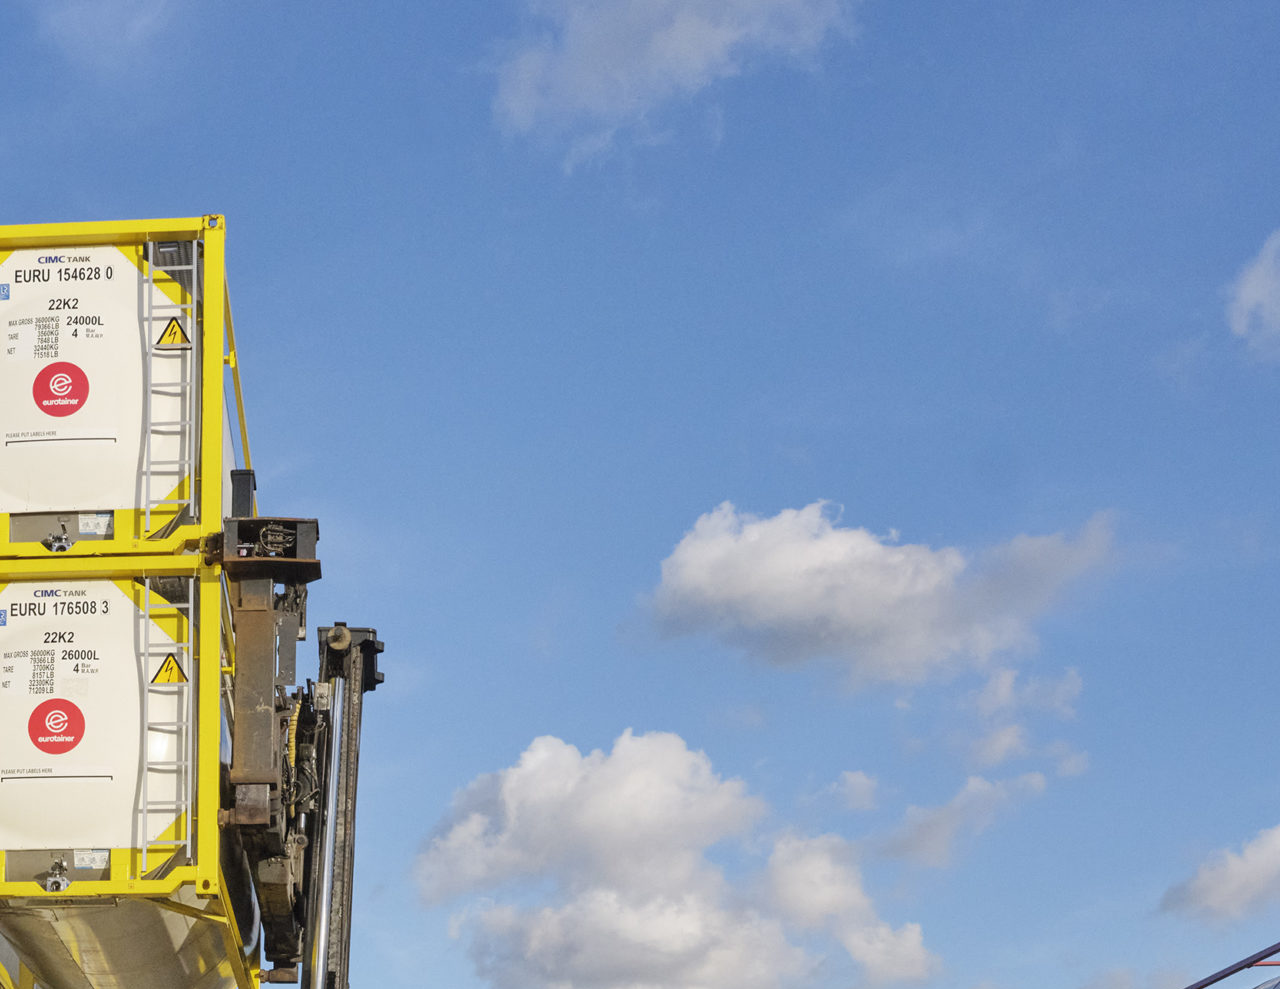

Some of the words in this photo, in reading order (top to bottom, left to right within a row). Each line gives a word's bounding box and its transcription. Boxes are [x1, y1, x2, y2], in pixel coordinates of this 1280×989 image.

[38, 256, 66, 264] CIMC
[15, 268, 51, 283] EURU
[57, 266, 101, 281] 154628
[106, 266, 113, 279] 0
[48, 298, 79, 311] 22K2
[66, 316, 104, 326] 24000L
[71, 328, 78, 338] 4
[42, 397, 79, 406] eurotainer
[10, 603, 46, 617] EURU
[53, 601, 97, 615] 176508
[102, 601, 109, 614] 3
[44, 632, 74, 643] 22K2
[14, 651, 29, 659] GROSS
[61, 650, 99, 660] 26000L
[73, 663, 79, 673] 4
[38, 735, 75, 743] eurotainer
